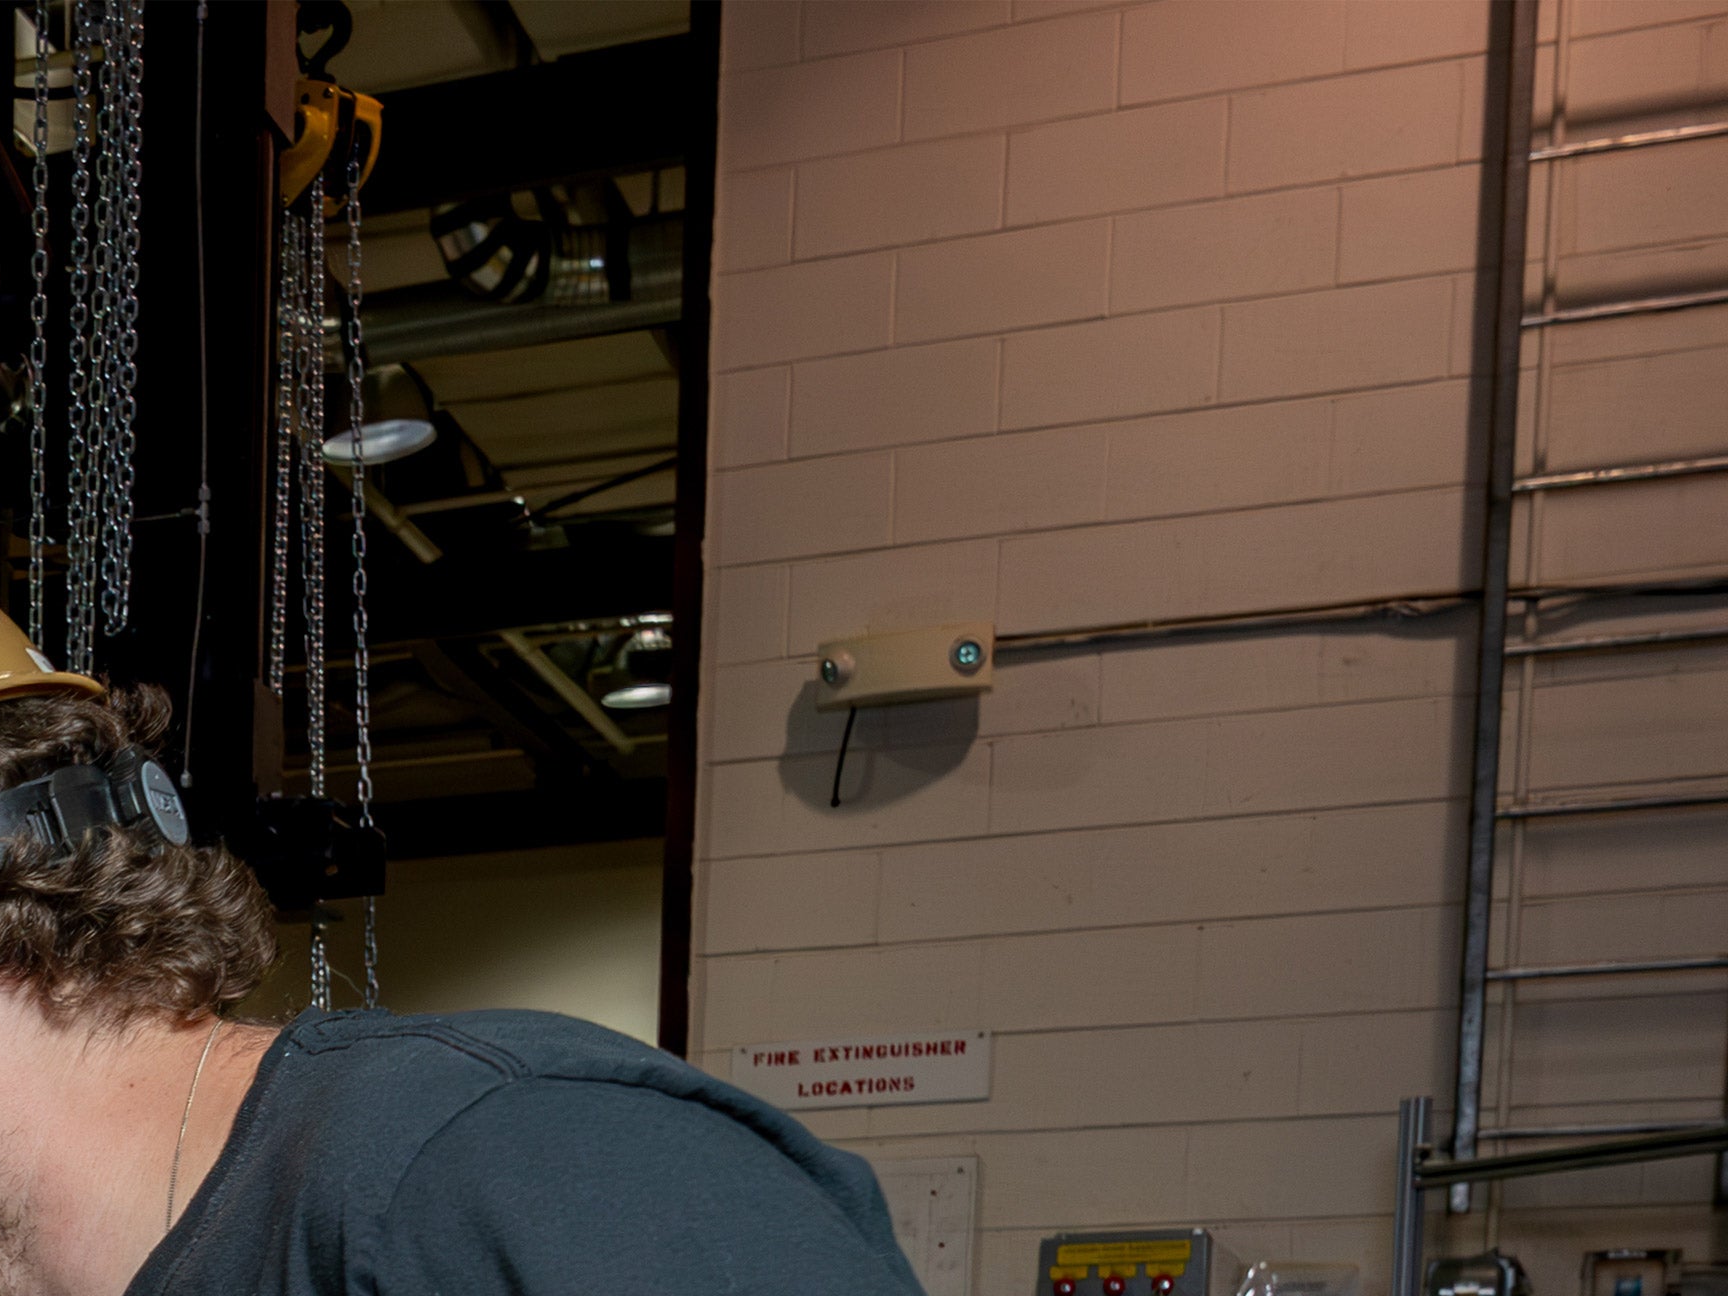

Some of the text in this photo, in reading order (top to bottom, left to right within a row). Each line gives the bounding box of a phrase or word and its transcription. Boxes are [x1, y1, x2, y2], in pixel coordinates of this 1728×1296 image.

[753, 1039, 967, 1067] FIRE EXTINGUISHER
[798, 1076, 915, 1098] LOCATIONS
